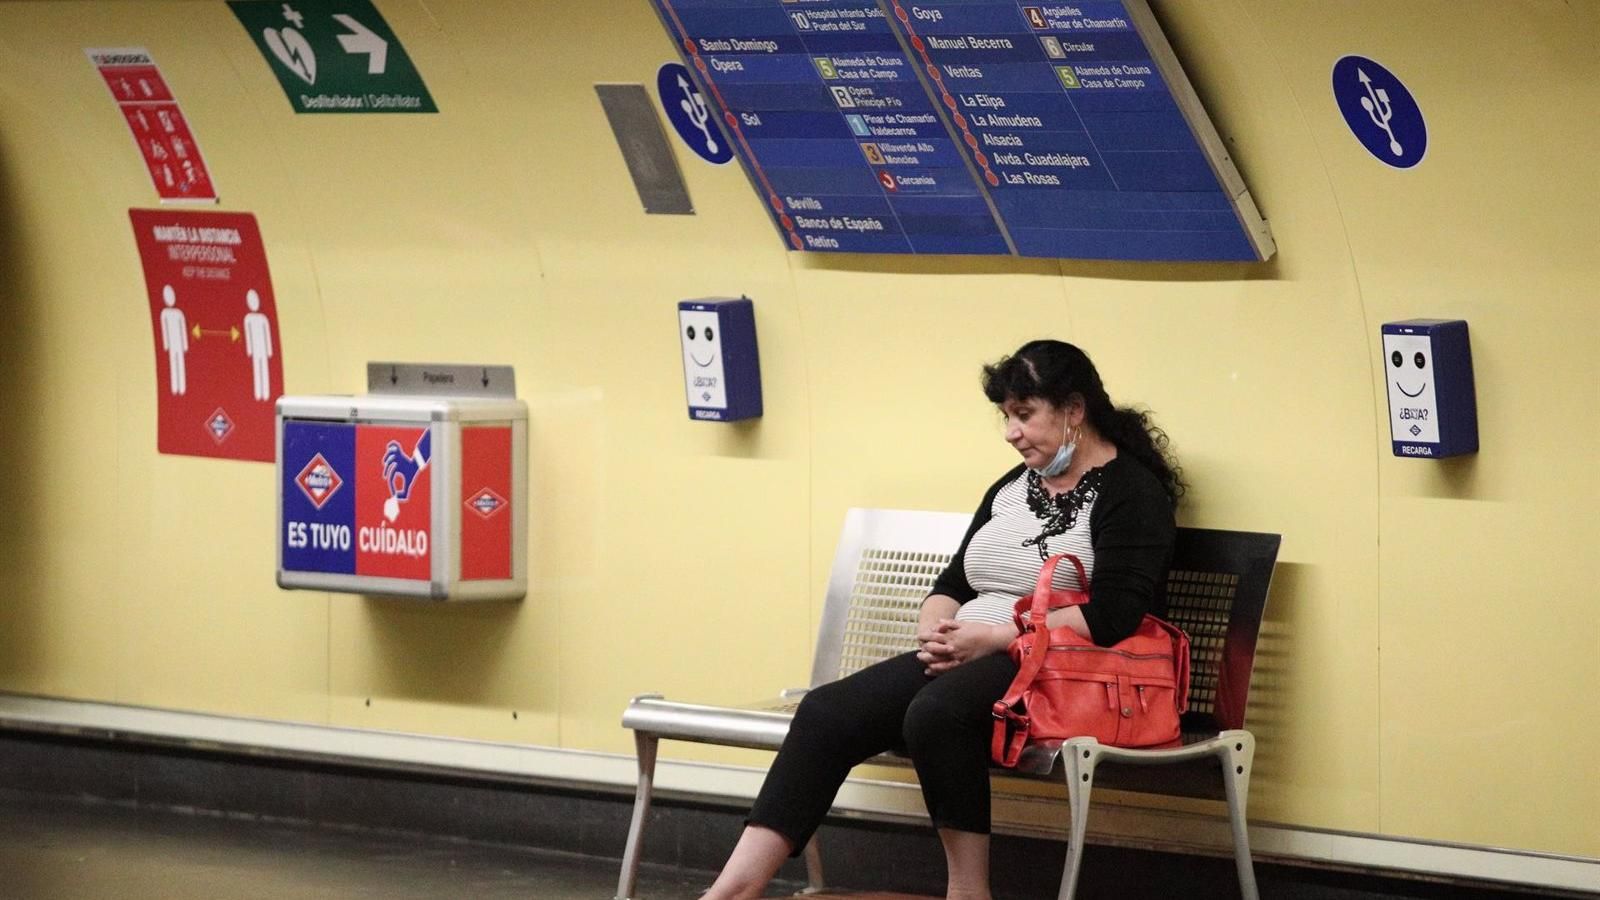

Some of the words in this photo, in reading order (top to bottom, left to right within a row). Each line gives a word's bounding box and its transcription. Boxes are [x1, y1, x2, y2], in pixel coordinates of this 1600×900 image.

[805, 9, 838, 20] Hospital
[837, 9, 866, 18] Infanta
[912, 6, 943, 22] Goya
[1030, 9, 1044, 27] 4
[1043, 7, 1082, 18] Argüelles
[791, 12, 810, 29] 10
[812, 21, 839, 31] Puerta
[839, 21, 852, 31] del
[851, 20, 866, 30] Sur
[1048, 19, 1071, 29] Pinar
[1072, 18, 1084, 28] de
[1084, 17, 1127, 28] Chamartín
[700, 38, 731, 51] Santo
[730, 38, 778, 53] Domingo
[927, 36, 968, 49] Manuel
[967, 36, 1013, 49] Becerra
[1047, 38, 1059, 56] 6
[1062, 42, 1095, 53] Circular
[819, 60, 833, 77] 5
[832, 57, 867, 67] Alameda
[866, 56, 877, 66] de
[876, 56, 903, 66] Osuna
[838, 69, 859, 79] Casa
[859, 69, 870, 79] de
[869, 68, 898, 80] Campo
[943, 65, 983, 78] Ventas
[1061, 69, 1075, 86] 5
[1075, 66, 1110, 76] Alameda
[1111, 65, 1122, 75] de
[1122, 65, 1151, 75] Osuna
[1080, 78, 1104, 89] Casa
[1104, 78, 1115, 88] de
[1114, 78, 1145, 89] Campo
[834, 89, 851, 106] R
[960, 94, 977, 107] La
[975, 94, 1006, 110] Elipa
[741, 112, 762, 126] Sol
[863, 114, 884, 124] Pinar
[885, 114, 896, 124] de
[970, 113, 988, 127] La
[987, 113, 1043, 127] Almudena
[869, 127, 917, 136] Valdecarros
[983, 132, 1024, 146] Alsacia
[867, 145, 880, 162] 3
[877, 142, 917, 153] Villaverde
[993, 152, 1026, 165] Avda.
[1024, 152, 1090, 169] Guadalajara
[1002, 171, 1025, 185] Las
[1023, 171, 1060, 185] Rosas
[786, 196, 823, 210] Sevilla
[795, 216, 830, 230] Banco
[830, 216, 844, 230] de
[844, 216, 884, 232] España
[805, 235, 840, 248] Retiro
[1402, 446, 1432, 455] RECARGA
[288, 521, 308, 548] ES
[310, 522, 351, 550] TUYO
[359, 520, 428, 557] CUÍDALO
